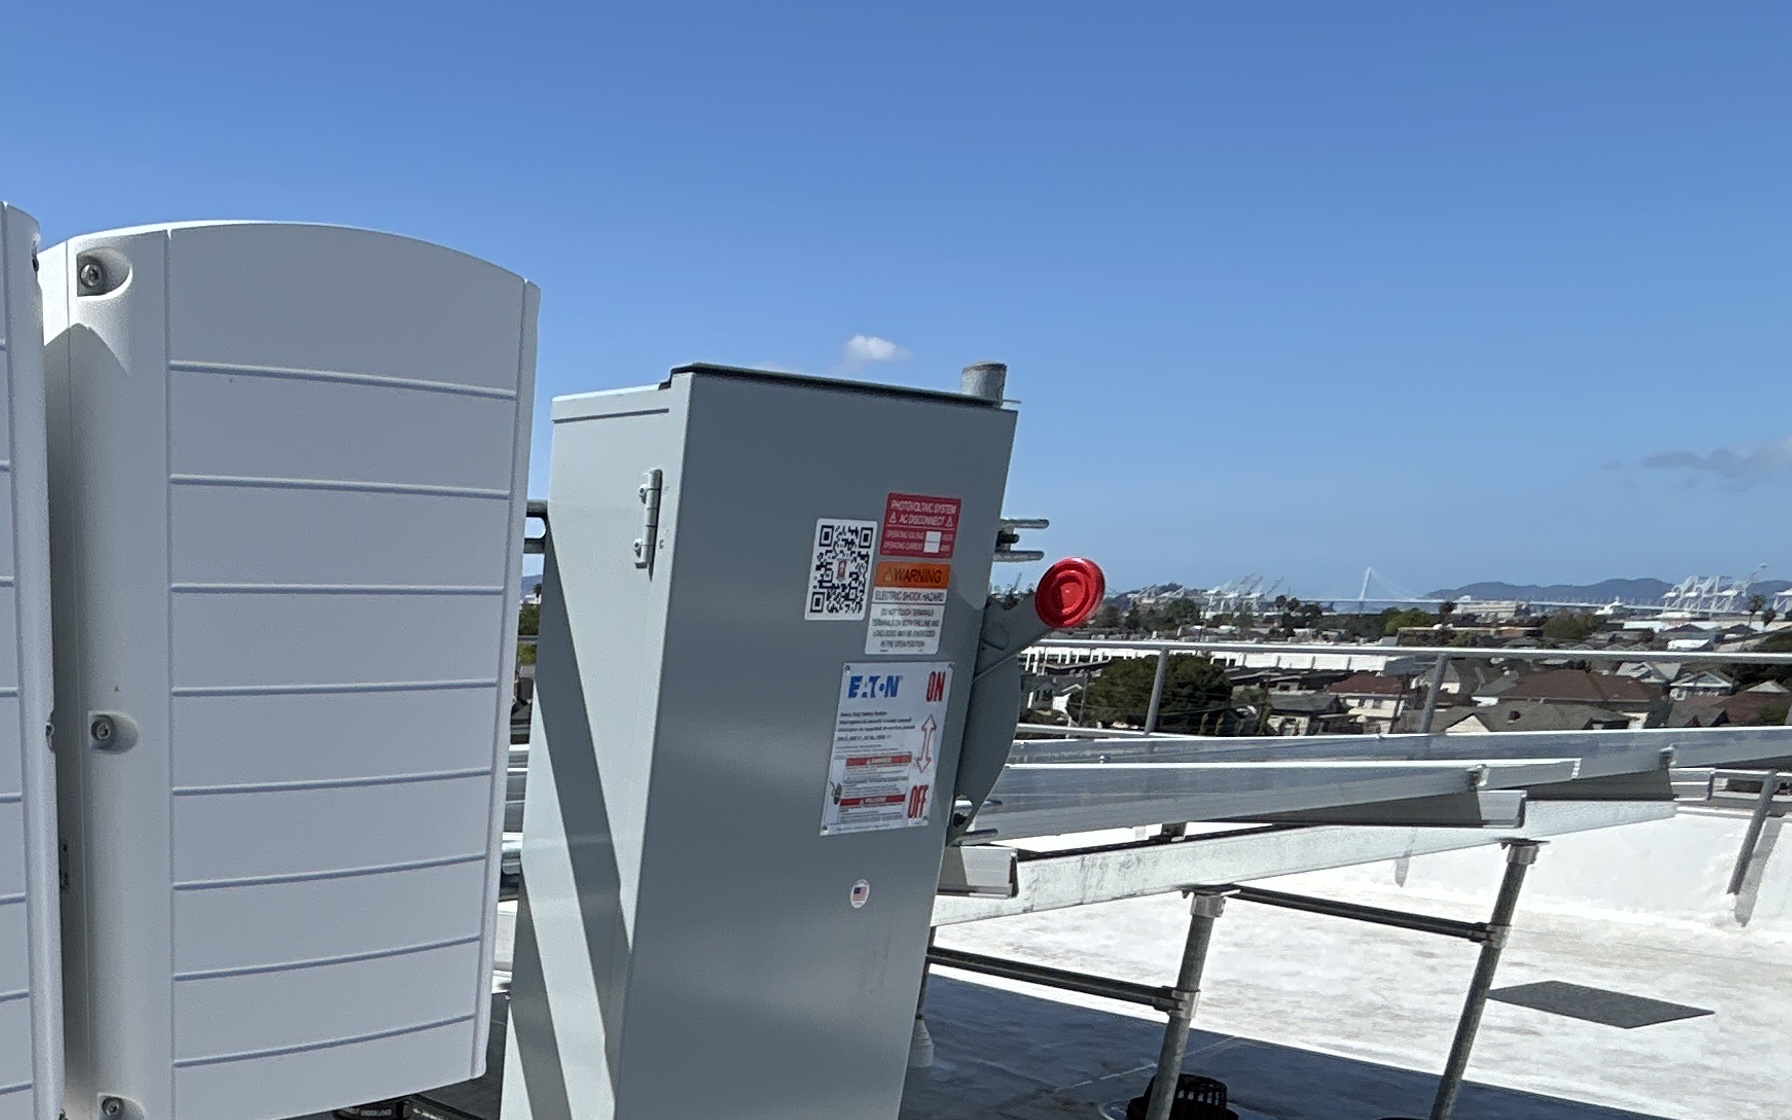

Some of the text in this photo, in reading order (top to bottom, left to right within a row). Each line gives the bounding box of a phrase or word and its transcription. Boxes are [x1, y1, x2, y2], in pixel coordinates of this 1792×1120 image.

[894, 567, 943, 584] WARNING
[926, 671, 946, 702] ON
[907, 784, 929, 818] OFF
